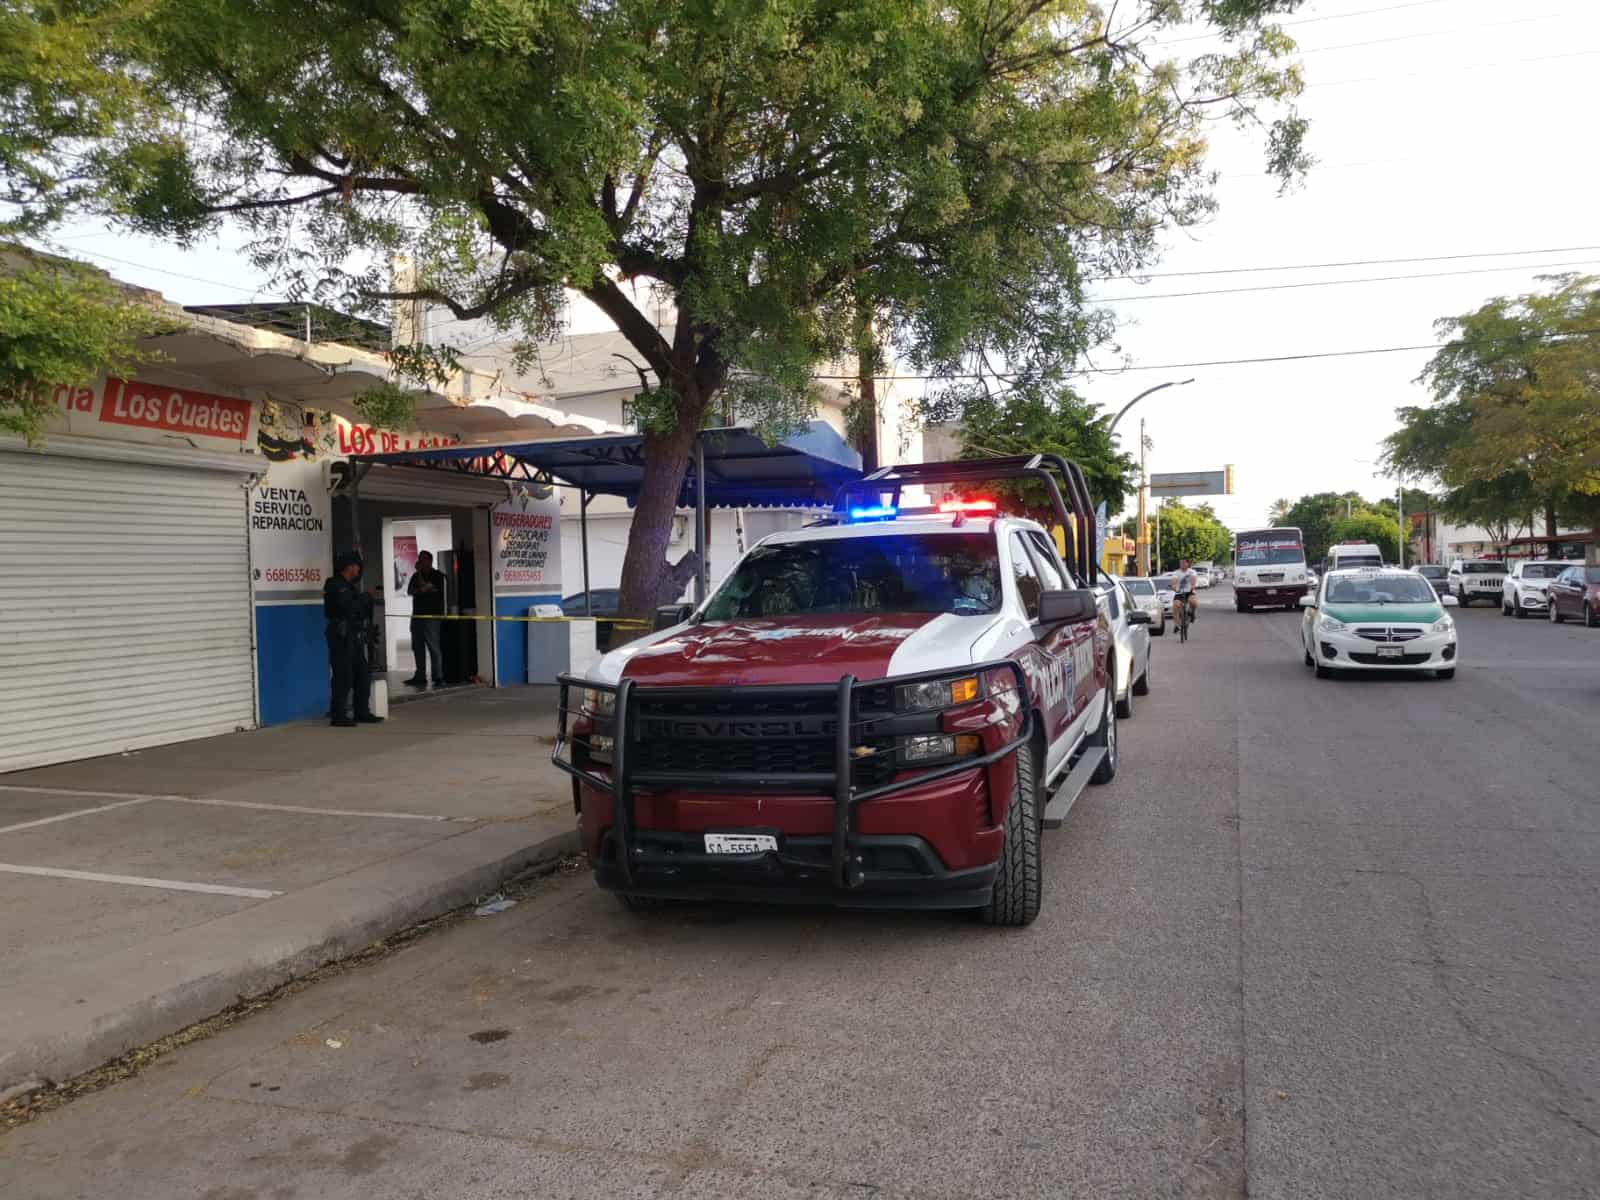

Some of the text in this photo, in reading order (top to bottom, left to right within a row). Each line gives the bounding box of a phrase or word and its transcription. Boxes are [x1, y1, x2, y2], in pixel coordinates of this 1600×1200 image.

[114, 384, 162, 423] Los
[165, 394, 245, 434] Cuates
[338, 423, 376, 455] LOS
[380, 431, 400, 453] DE
[259, 487, 307, 502] VENTA
[254, 501, 313, 516] SERVICIO
[252, 515, 323, 532] REPARACION
